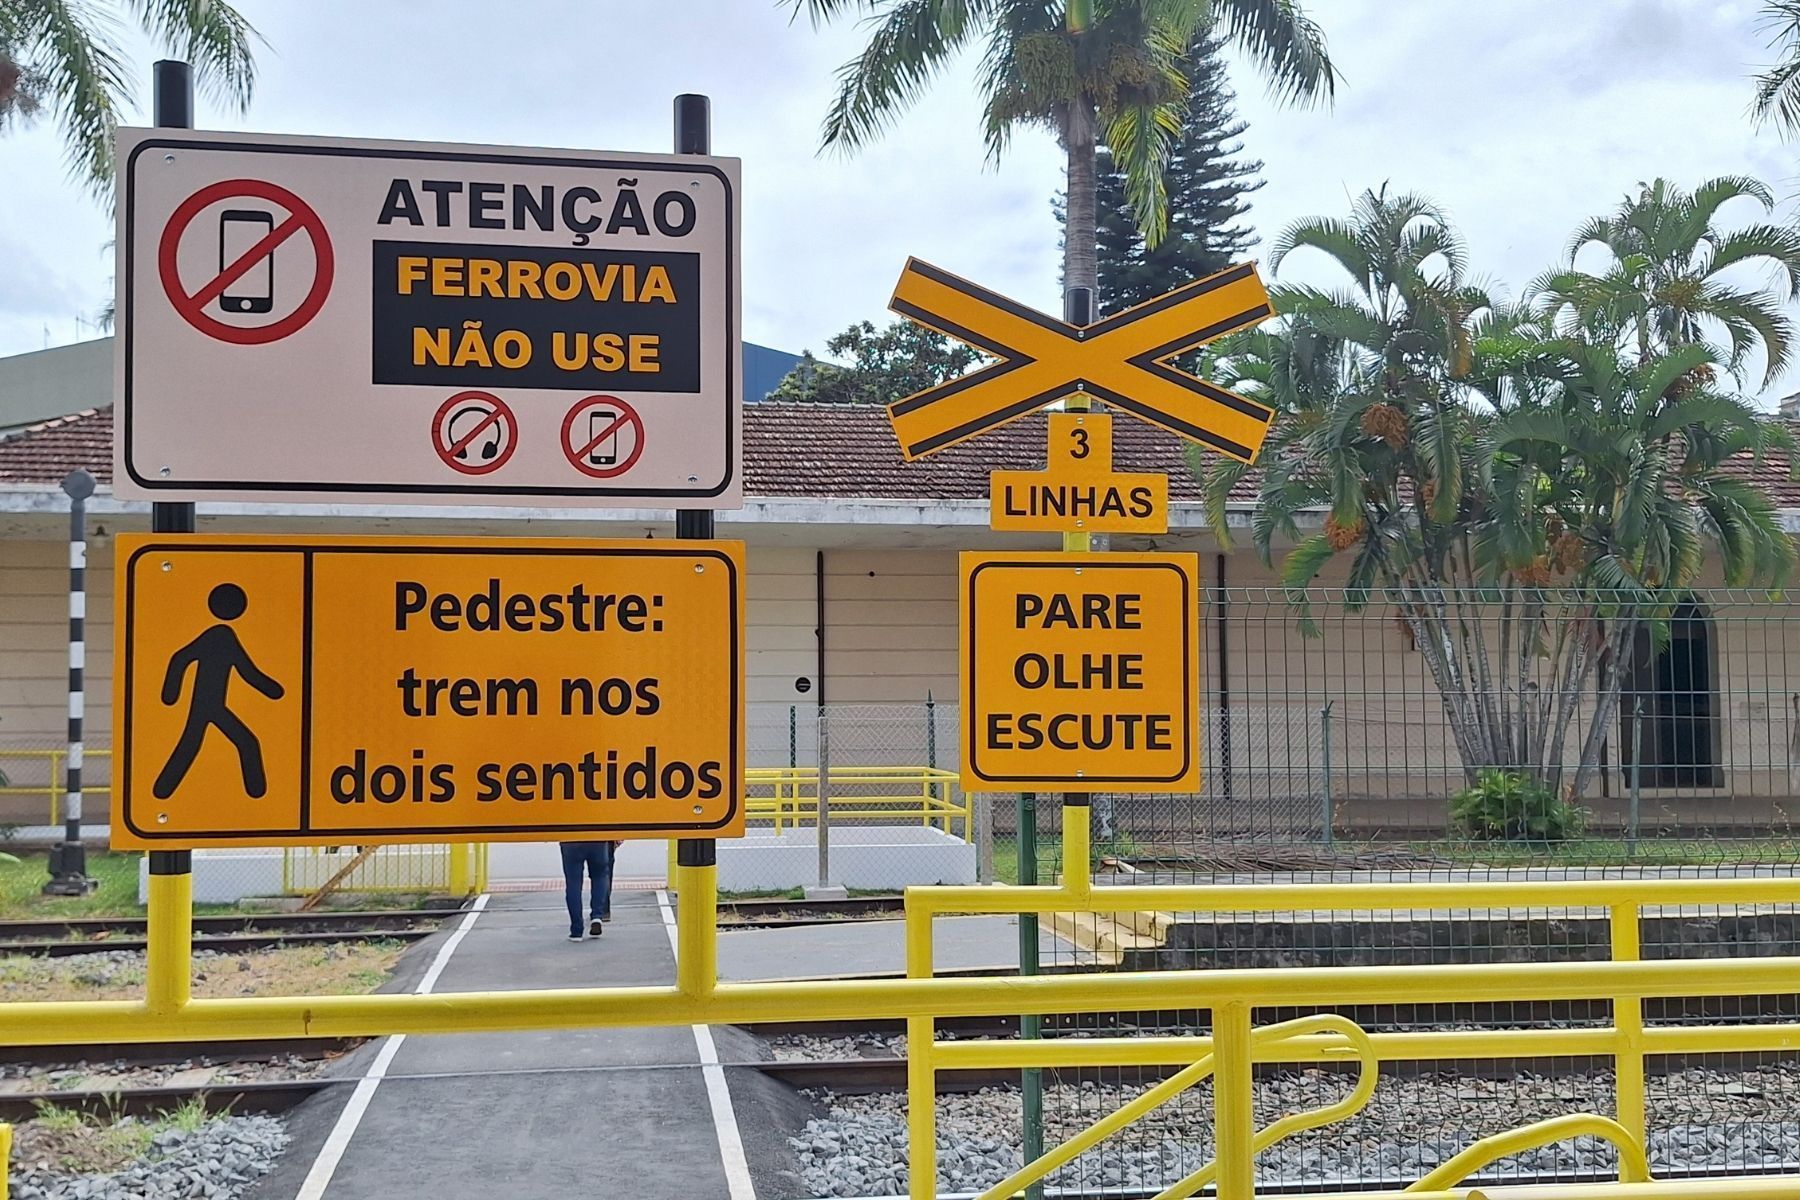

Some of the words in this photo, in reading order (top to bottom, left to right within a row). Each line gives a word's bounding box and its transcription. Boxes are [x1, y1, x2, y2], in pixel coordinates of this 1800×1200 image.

[377, 177, 697, 246] ATENÇÃO
[396, 256, 677, 304] FERROVIA
[411, 320, 533, 370] NÃO
[551, 331, 662, 374] USE
[1069, 428, 1090, 460] 3
[1005, 485, 1153, 518] LINHAS
[394, 578, 664, 632] Pedestre:
[1015, 593, 1142, 630] PARE
[397, 667, 538, 716] trem
[560, 676, 660, 716] nos
[1014, 653, 1143, 690] OLHE
[987, 713, 1172, 750] ESCUTE
[330, 749, 456, 803] dois
[476, 746, 723, 802] sentidos
